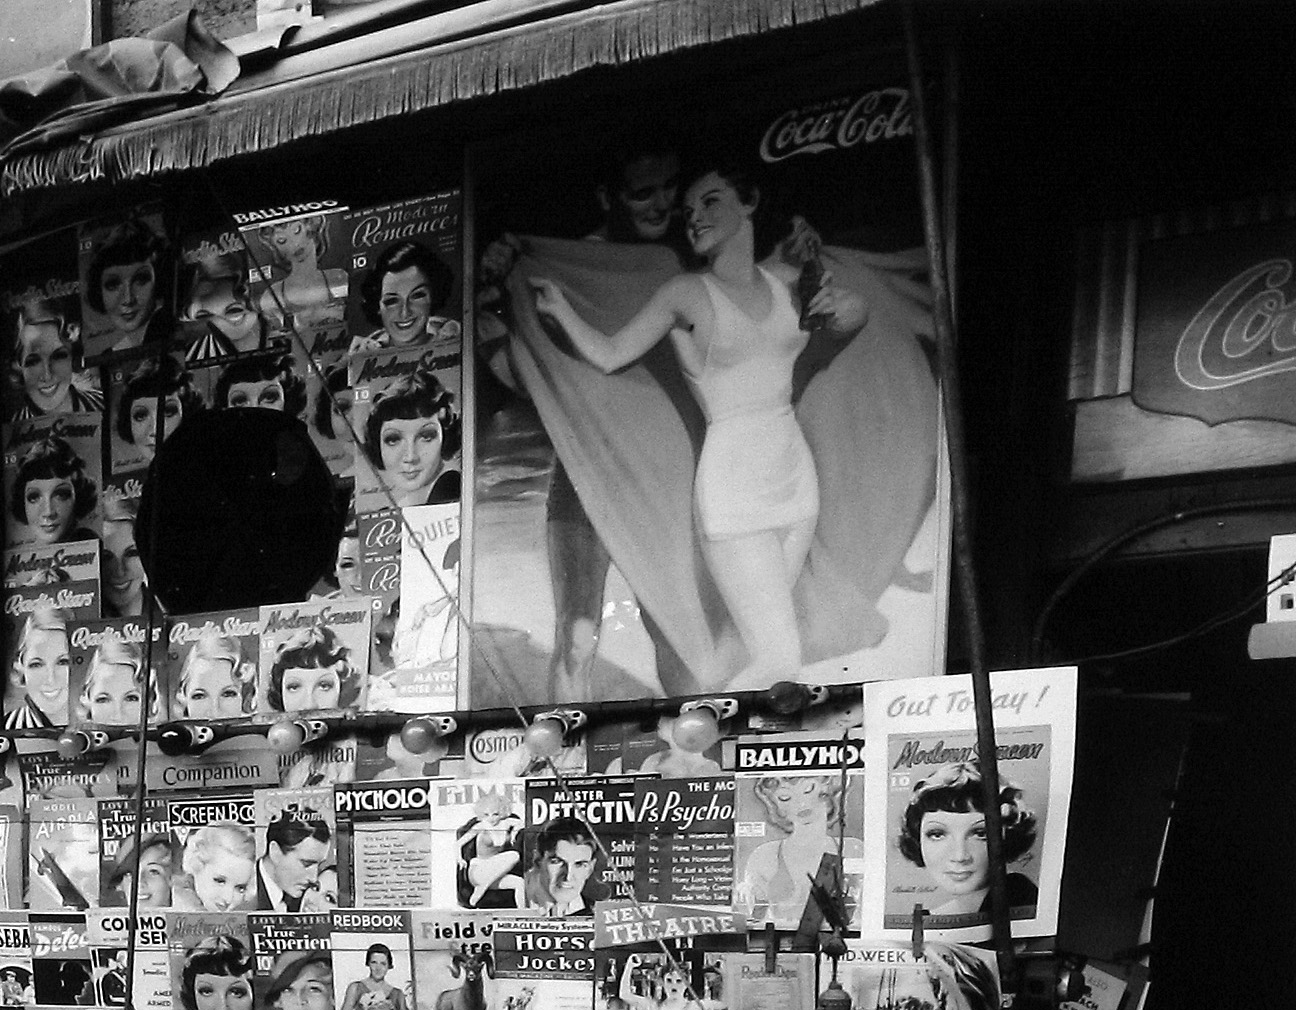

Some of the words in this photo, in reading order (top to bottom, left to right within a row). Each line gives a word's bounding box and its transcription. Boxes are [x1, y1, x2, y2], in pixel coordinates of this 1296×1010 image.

[759, 87, 914, 163] Coca-Cola
[945, 684, 1051, 721] Toay!
[162, 763, 260, 785] Companion
[688, 782, 712, 793] THE
[332, 913, 403, 929] REDBOOK
